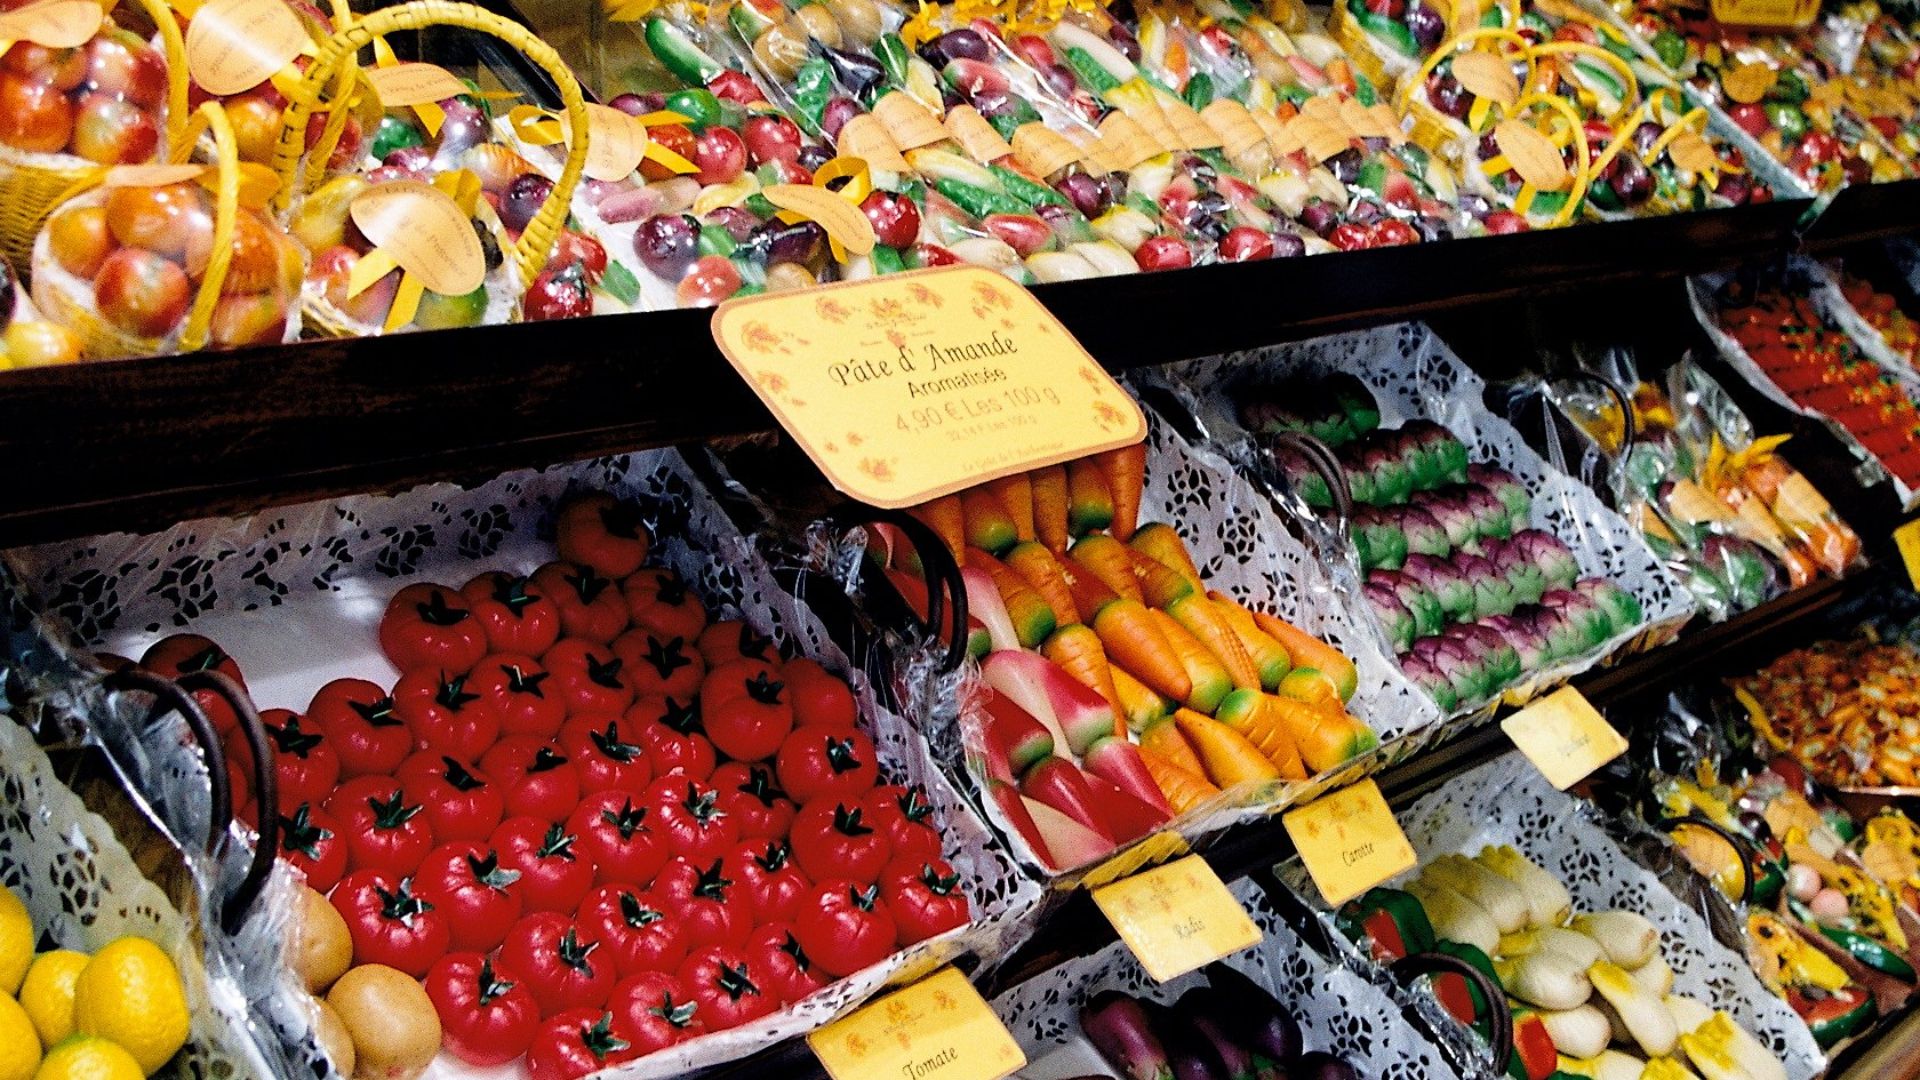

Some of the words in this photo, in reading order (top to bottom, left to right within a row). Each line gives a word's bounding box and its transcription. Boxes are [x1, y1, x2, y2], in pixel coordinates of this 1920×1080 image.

[827, 358, 893, 387] Pâte
[923, 329, 1019, 372] Amande
[907, 366, 1008, 399] Aromatisée
[896, 405, 943, 434] 4,90
[944, 400, 963, 421] €
[961, 396, 1003, 418] Les
[1003, 385, 1041, 408] 100
[1042, 386, 1061, 406] g
[1342, 842, 1375, 867] Carotte
[902, 1047, 959, 1080] Tomate
